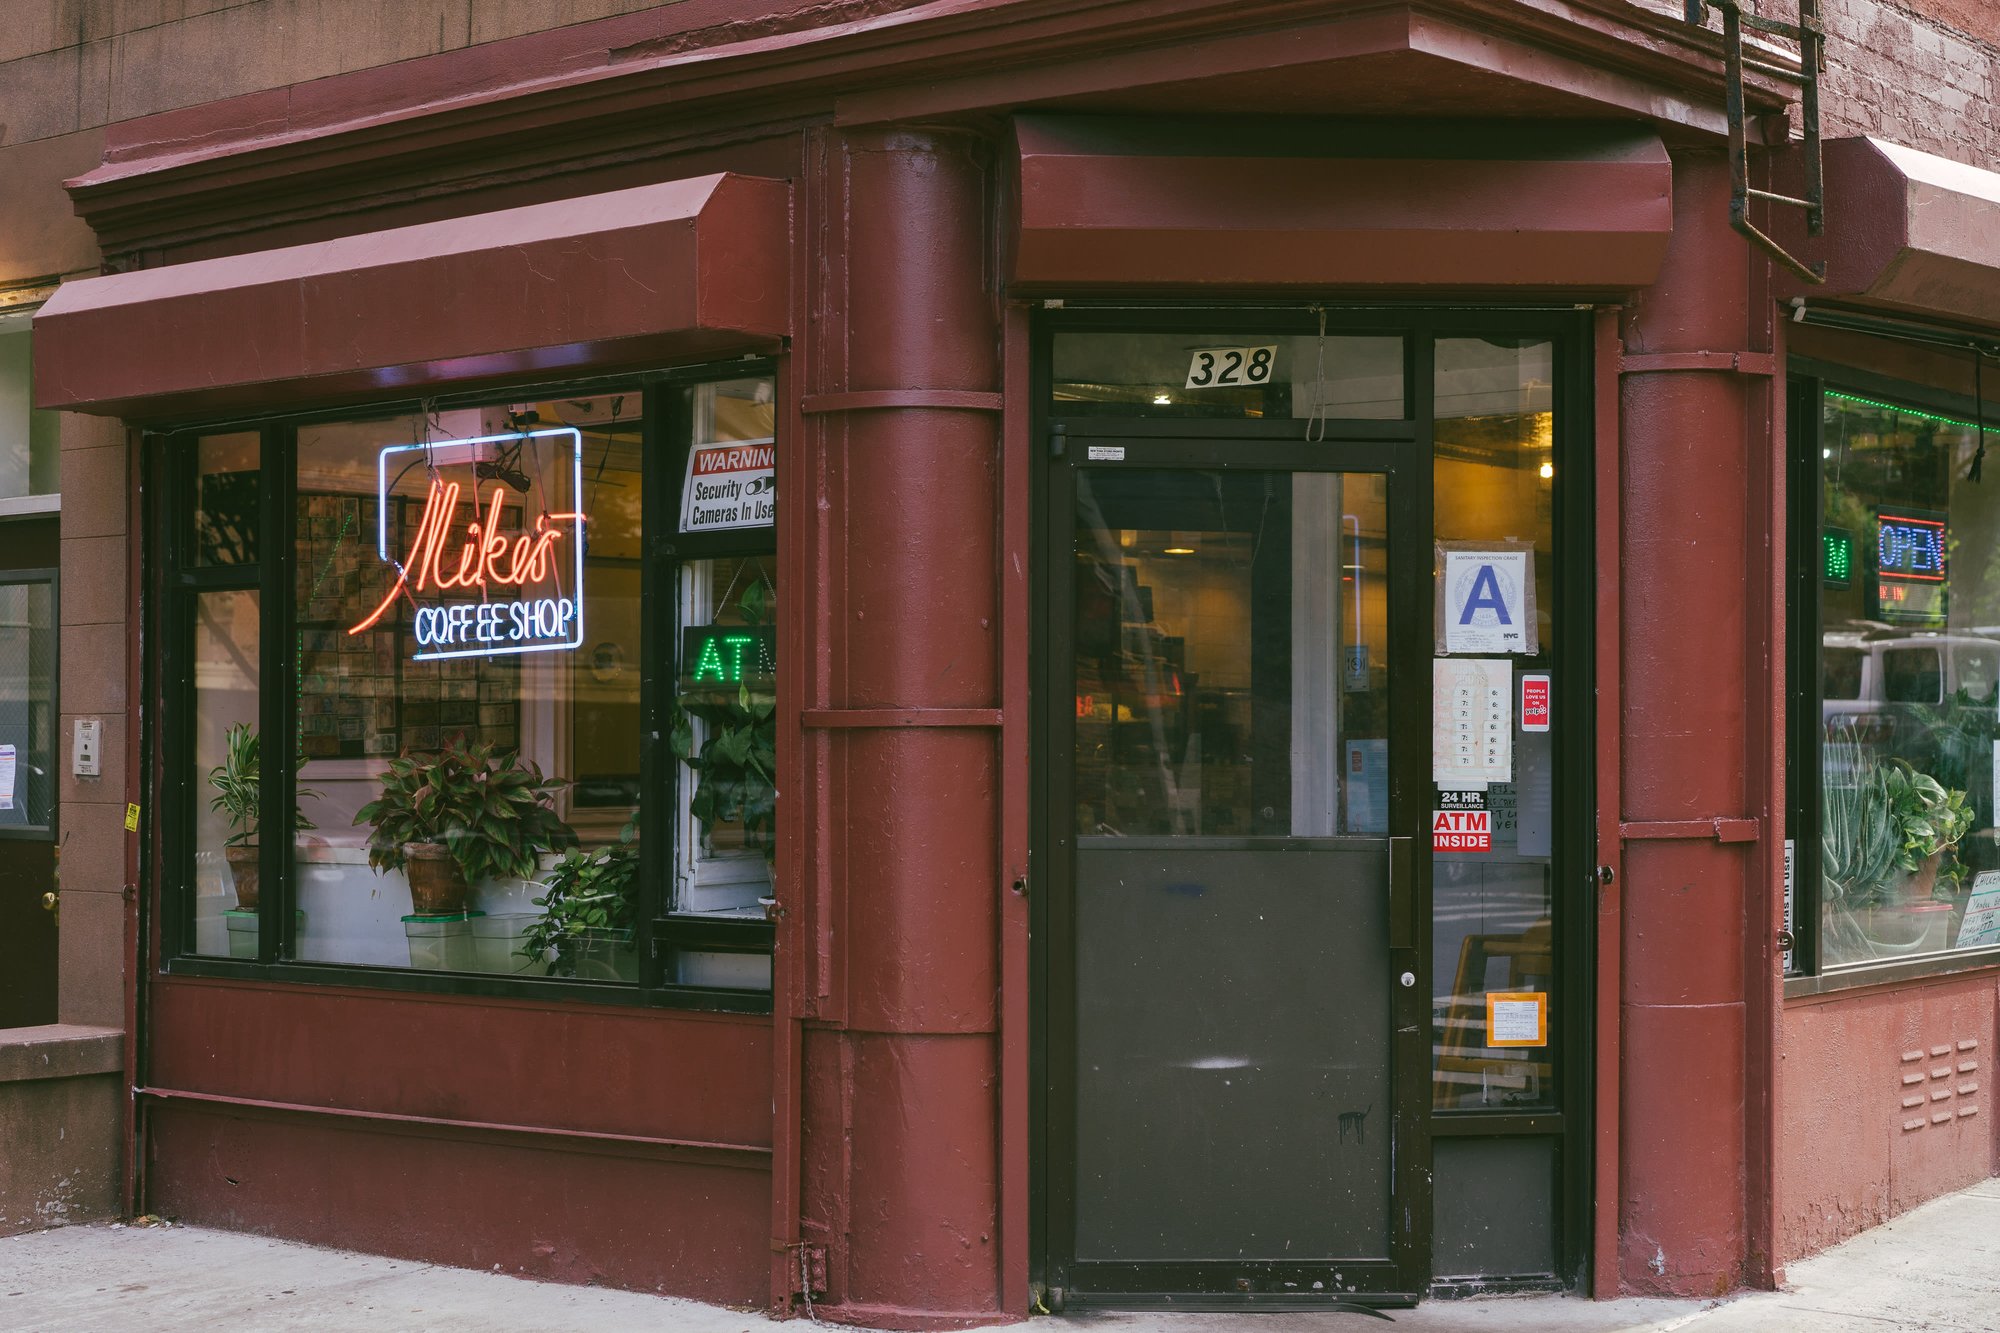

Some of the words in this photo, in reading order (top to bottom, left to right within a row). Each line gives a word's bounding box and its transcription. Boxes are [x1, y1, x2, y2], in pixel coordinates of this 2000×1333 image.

[1190, 348, 1272, 386] 328
[695, 480, 742, 501] Security
[692, 506, 738, 525] Cameras
[741, 502, 751, 520] In
[755, 501, 774, 519] Use
[1823, 537, 1846, 578] M
[1880, 525, 1941, 570] OPEN
[1459, 565, 1512, 625] A
[415, 603, 508, 645] COFFEE
[509, 598, 573, 641] SHOP
[1441, 792, 1458, 803] 24
[1461, 792, 1484, 803] HR.
[1434, 812, 1487, 831] ATM
[1434, 835, 1488, 847] INSIDE
